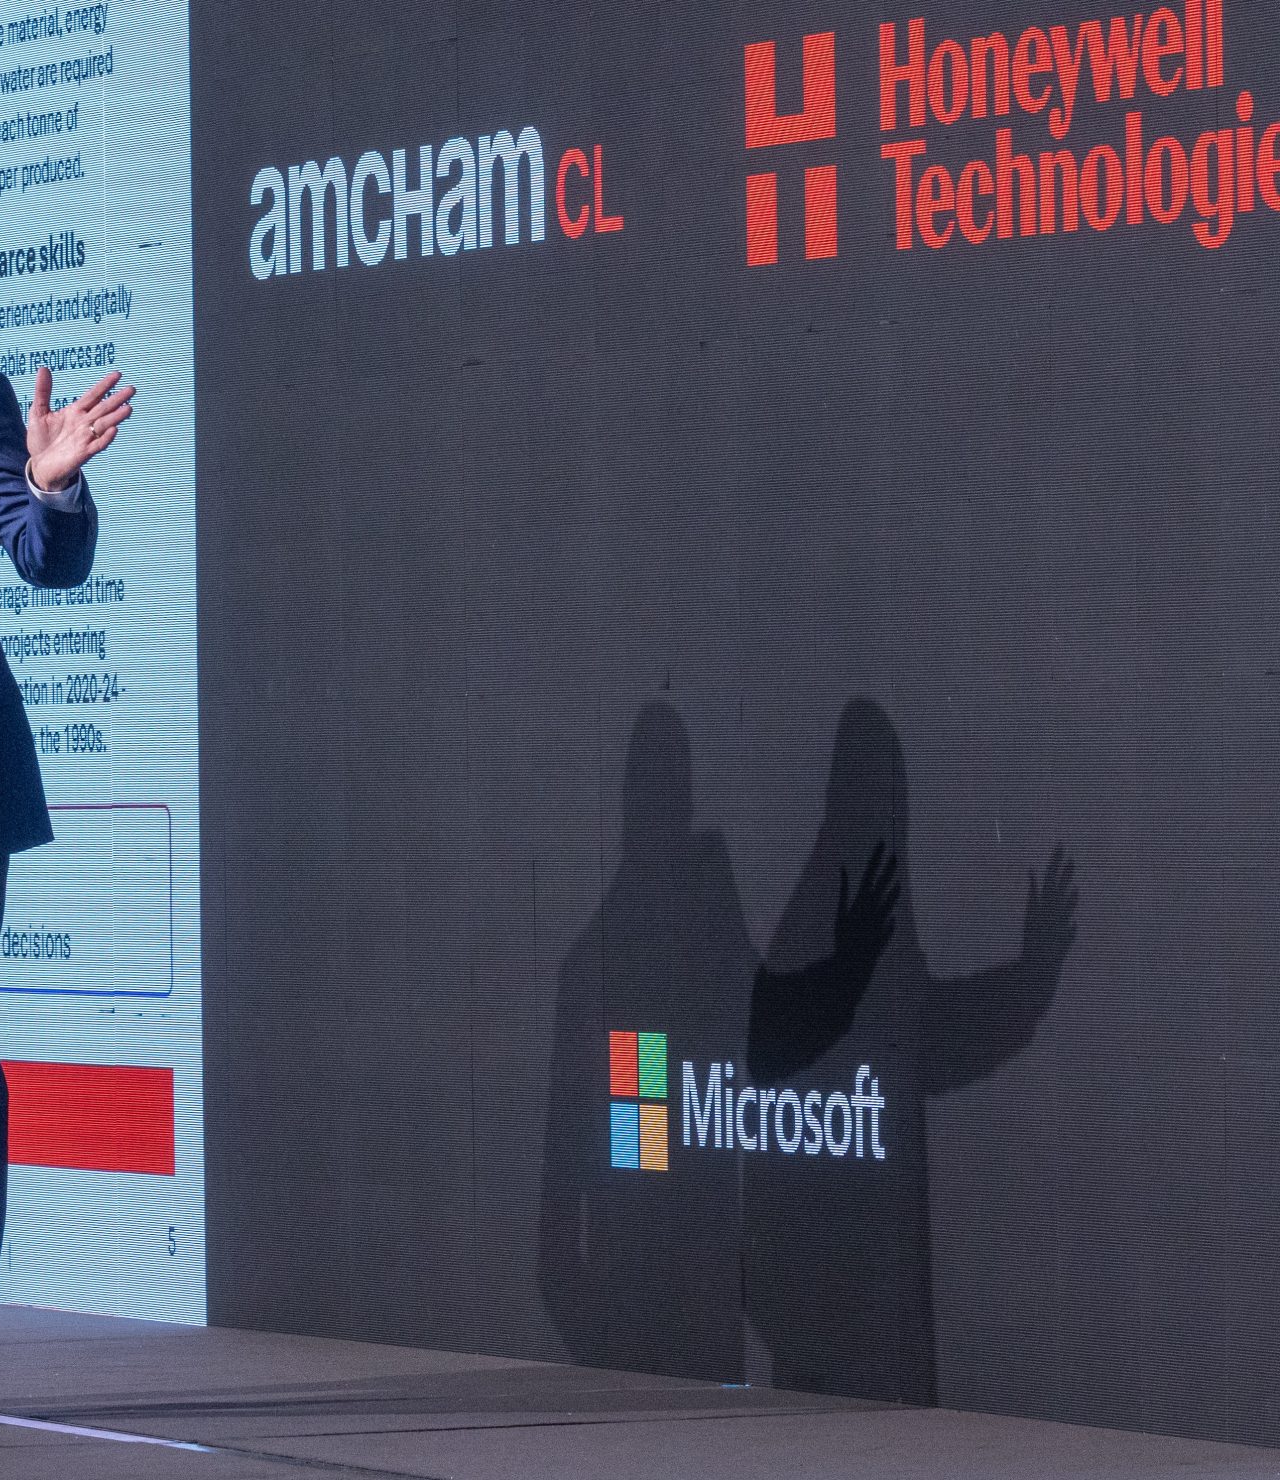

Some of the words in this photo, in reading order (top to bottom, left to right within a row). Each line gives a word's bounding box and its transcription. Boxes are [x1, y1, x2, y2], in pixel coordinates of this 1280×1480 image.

[8, 7, 63, 44] material,
[66, 2, 109, 34] energy
[0, 65, 37, 95] water
[38, 66, 57, 88] are
[60, 45, 113, 86] required
[878, 0, 1224, 139] Honeywell
[26, 109, 62, 139] tonne
[67, 102, 79, 130] of
[22, 151, 85, 193] produced.
[880, 91, 1280, 250] Technologie
[556, 144, 624, 239] CL
[39, 230, 86, 273] skills
[55, 291, 81, 320] and
[81, 283, 133, 324] digitally
[29, 345, 92, 374] resources
[95, 342, 115, 367] are
[96, 574, 125, 603] time
[54, 625, 106, 660] entering
[52, 675, 63, 704] in
[40, 724, 60, 754] the
[65, 723, 107, 753] 1990s.
[3, 923, 71, 959] decisions
[682, 1061, 886, 1160] Microsoft
[168, 1226, 176, 1256] 5
